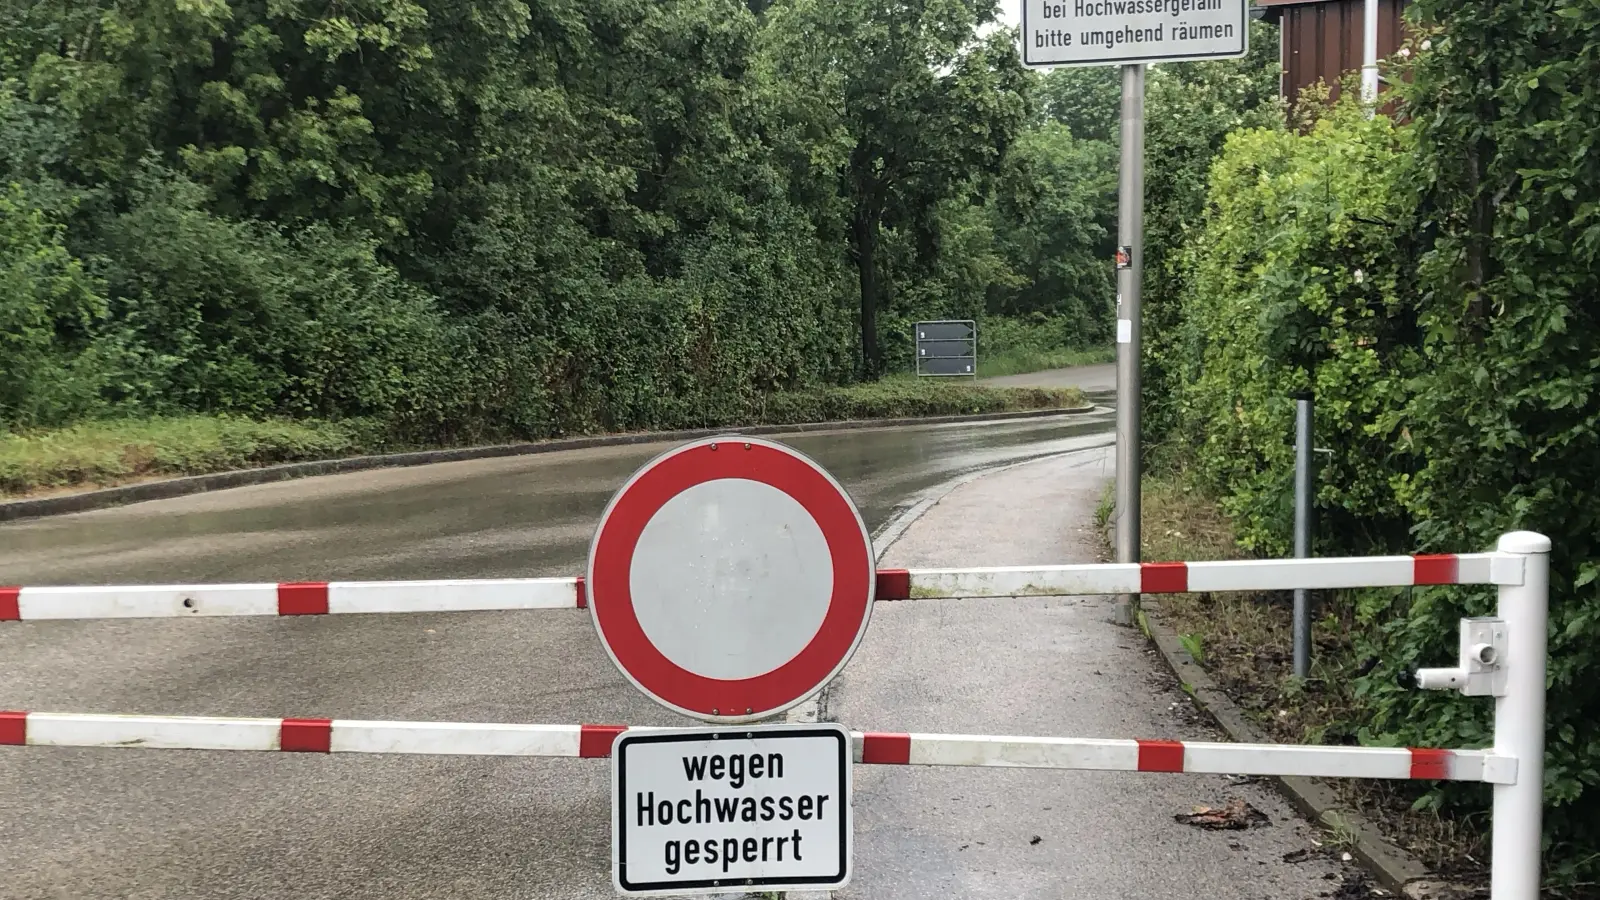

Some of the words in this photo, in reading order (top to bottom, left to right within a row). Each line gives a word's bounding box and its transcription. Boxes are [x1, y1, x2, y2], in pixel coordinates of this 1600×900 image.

[1043, 0, 1066, 19] bei
[1035, 30, 1072, 48] bitte
[1080, 23, 1163, 49] umgehend
[1172, 22, 1234, 41] räumen
[682, 753, 784, 789] wegen
[637, 789, 829, 826] Hochwasser
[664, 829, 802, 875] gesperrt
